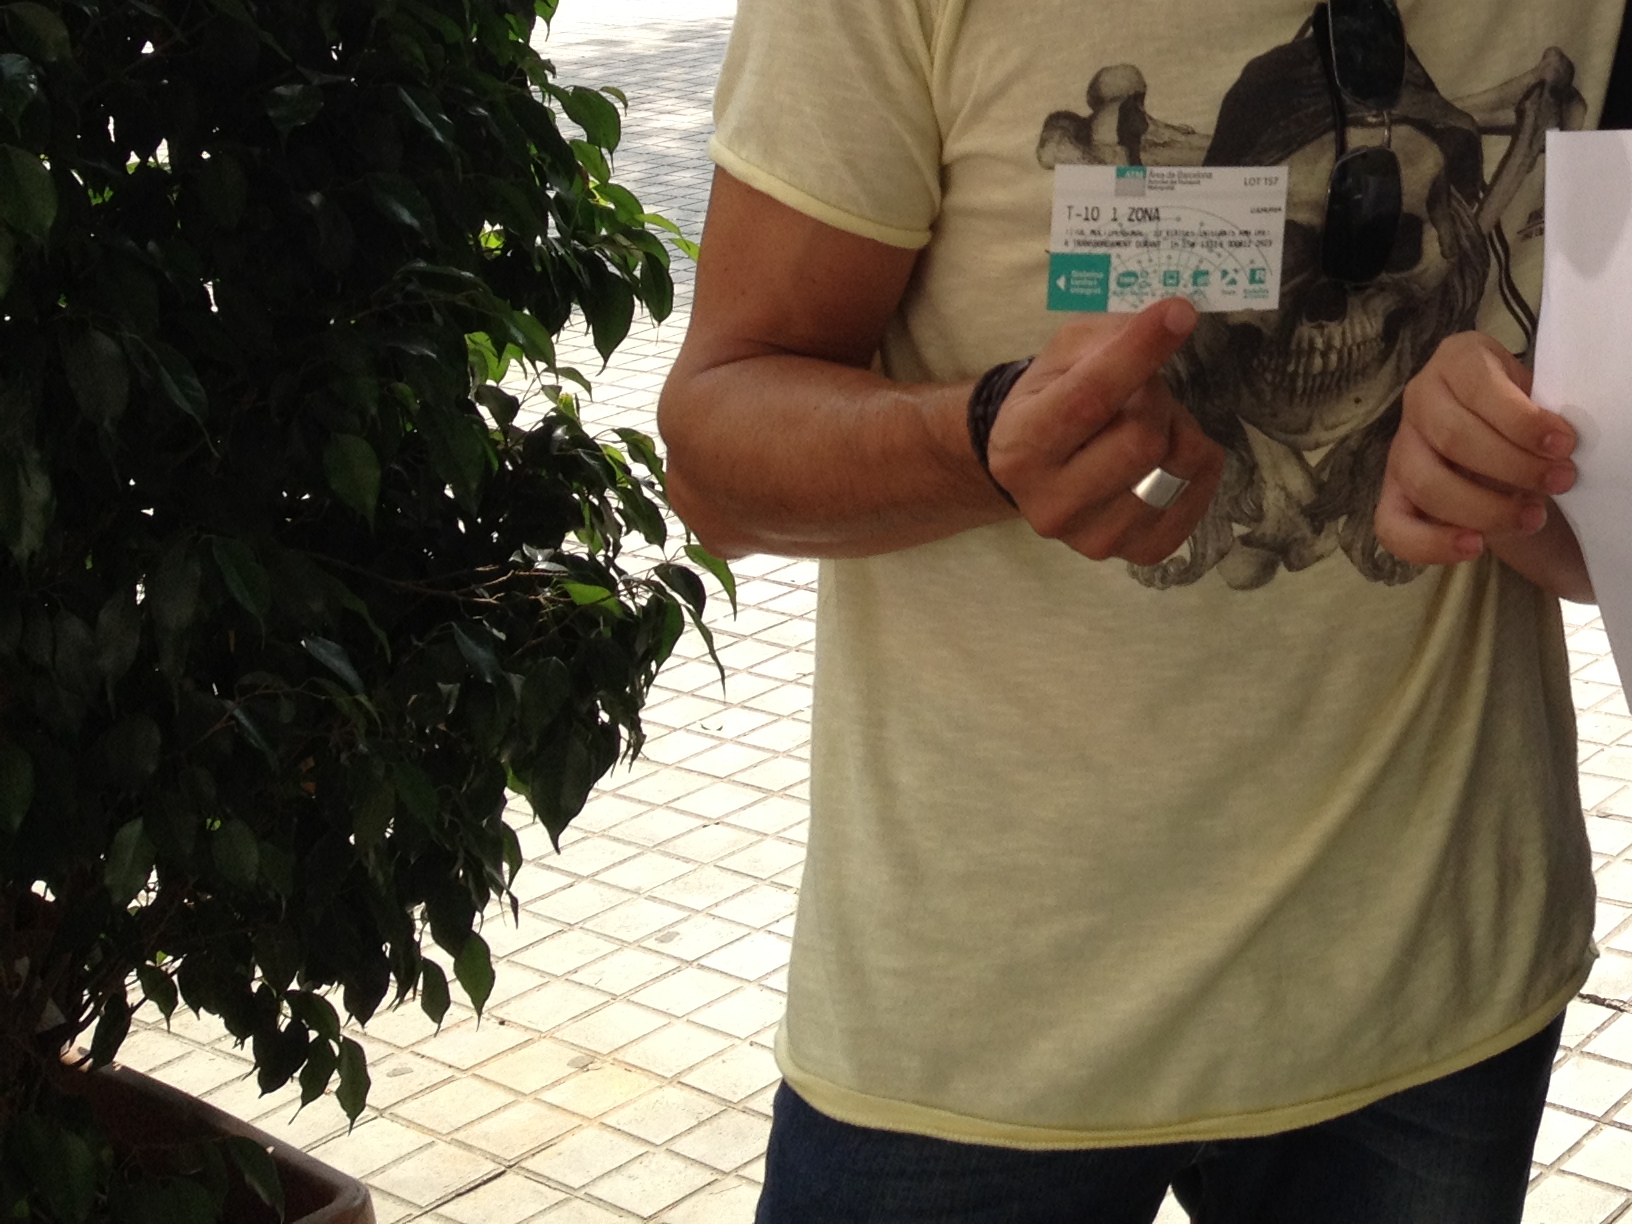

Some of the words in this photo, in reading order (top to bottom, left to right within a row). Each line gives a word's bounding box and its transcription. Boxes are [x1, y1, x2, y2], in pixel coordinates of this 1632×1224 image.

[1067, 206, 1100, 222] T-10
[1111, 207, 1118, 222] 1
[1127, 207, 1160, 223] ZONA
